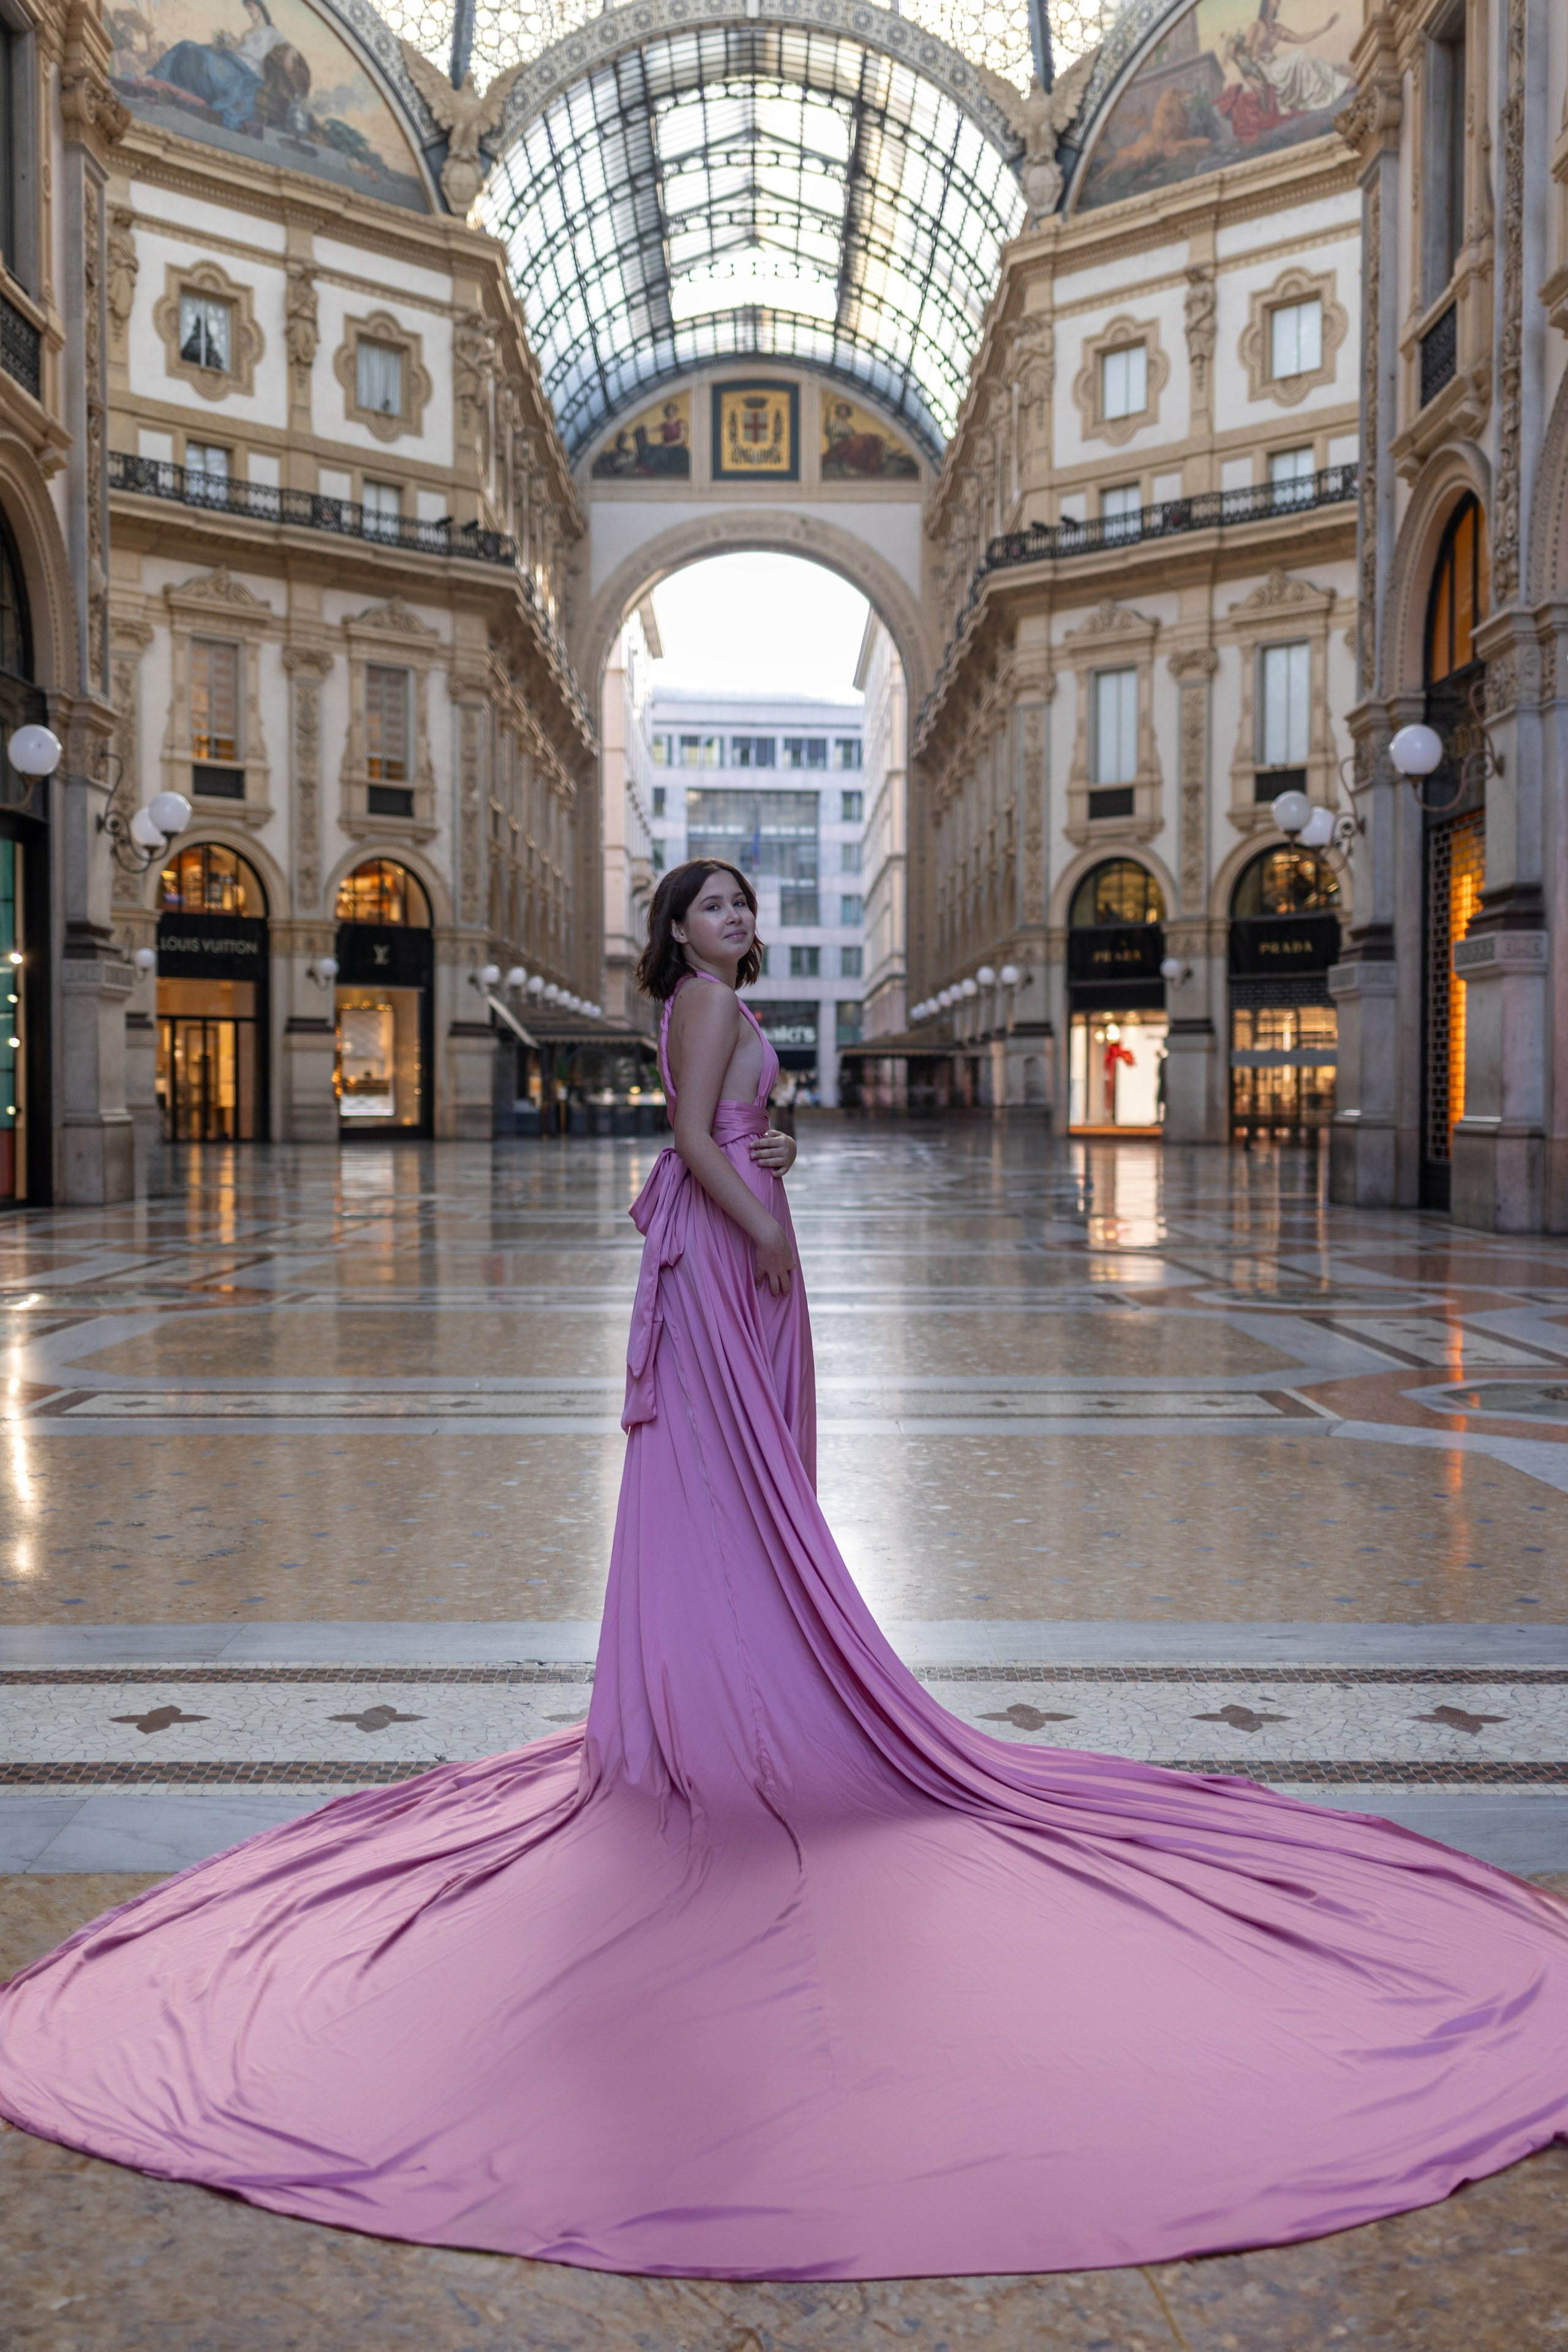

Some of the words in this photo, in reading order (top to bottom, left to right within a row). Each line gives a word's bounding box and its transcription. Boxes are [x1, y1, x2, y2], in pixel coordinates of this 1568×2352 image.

[160, 936, 200, 952] LOUIS
[201, 938, 259, 955] VUITTON
[1259, 940, 1313, 955] PRADA
